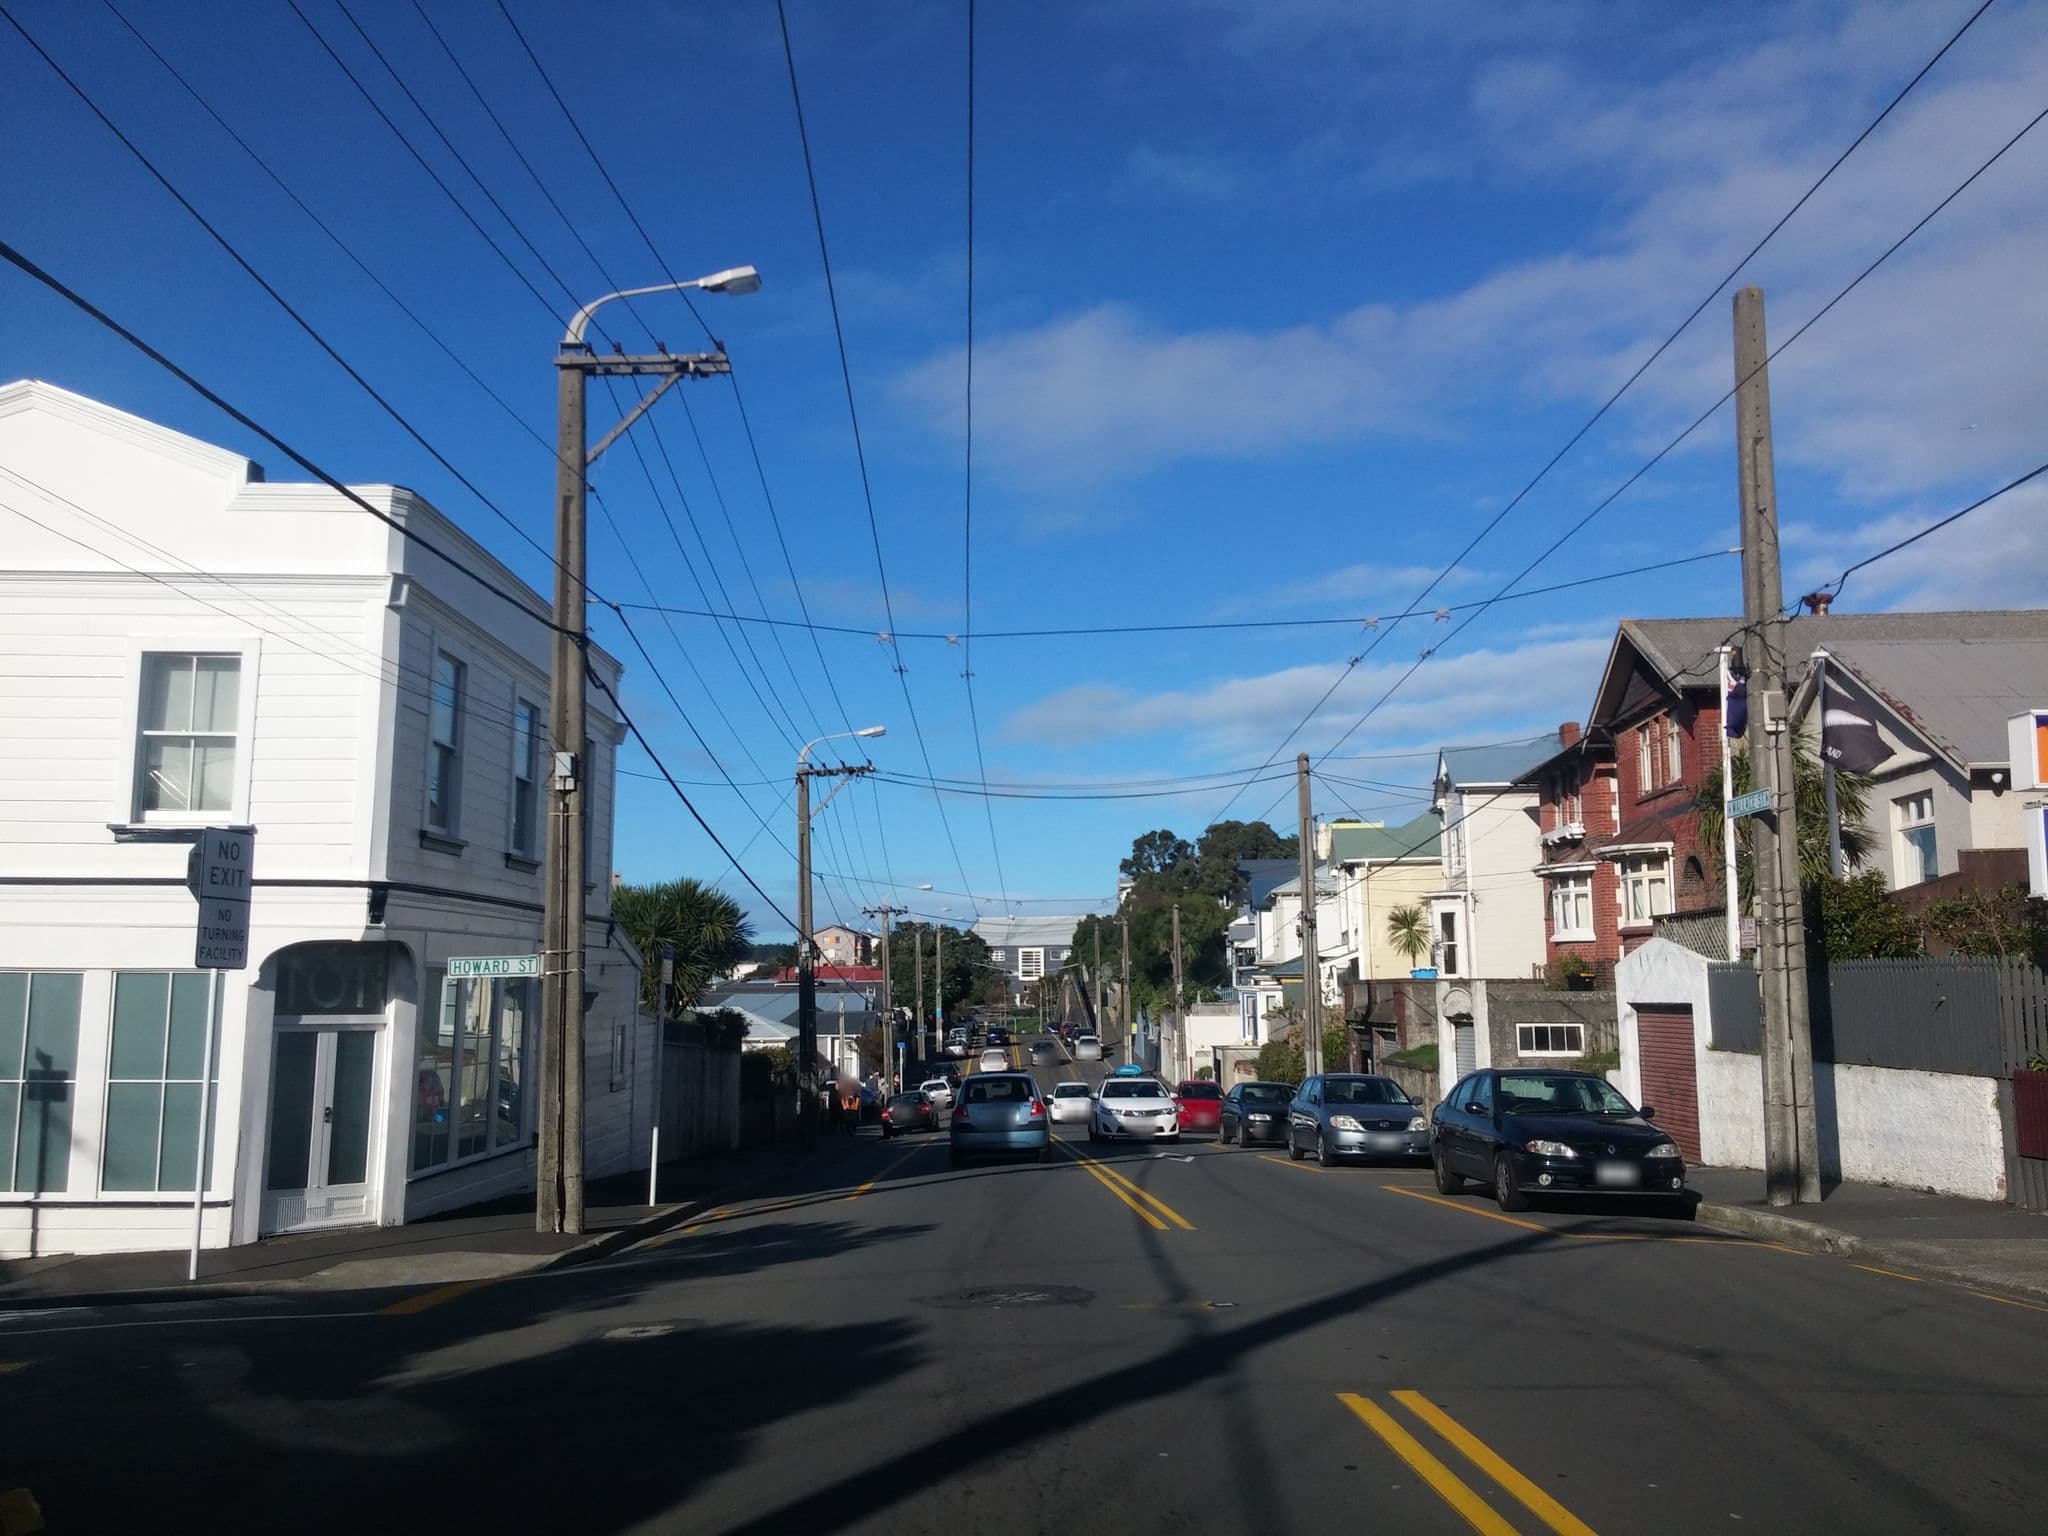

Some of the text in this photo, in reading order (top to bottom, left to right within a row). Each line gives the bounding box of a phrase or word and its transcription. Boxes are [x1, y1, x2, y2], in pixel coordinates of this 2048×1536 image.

[218, 840, 241, 861] NO
[210, 866, 246, 888] EXIT
[218, 909, 232, 922] NO
[203, 927, 245, 942] TURNING
[200, 946, 244, 961] FACILITY
[453, 959, 534, 974] HOWARD ST
